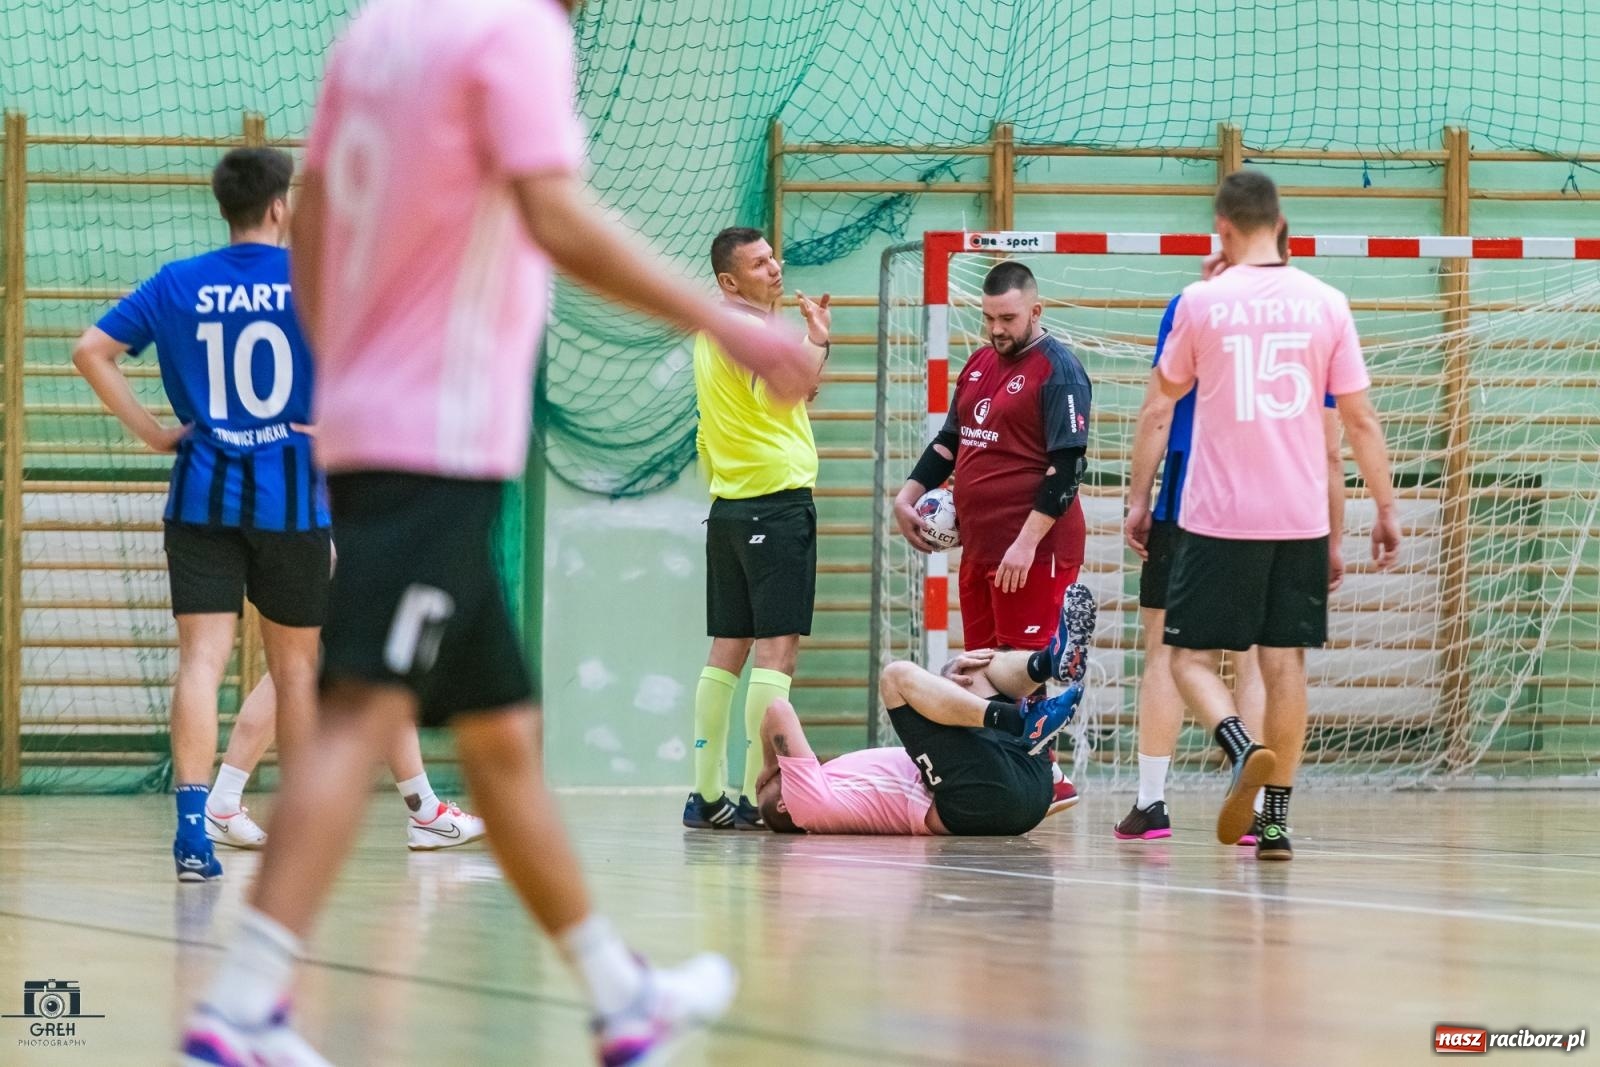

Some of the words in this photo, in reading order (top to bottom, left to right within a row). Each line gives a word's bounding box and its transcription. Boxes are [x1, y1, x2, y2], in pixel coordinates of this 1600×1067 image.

[1006, 237, 1039, 248] sport
[195, 283, 292, 313] START
[1209, 298, 1323, 329] PATRYK
[196, 320, 294, 420] 10
[1222, 331, 1313, 422] 15
